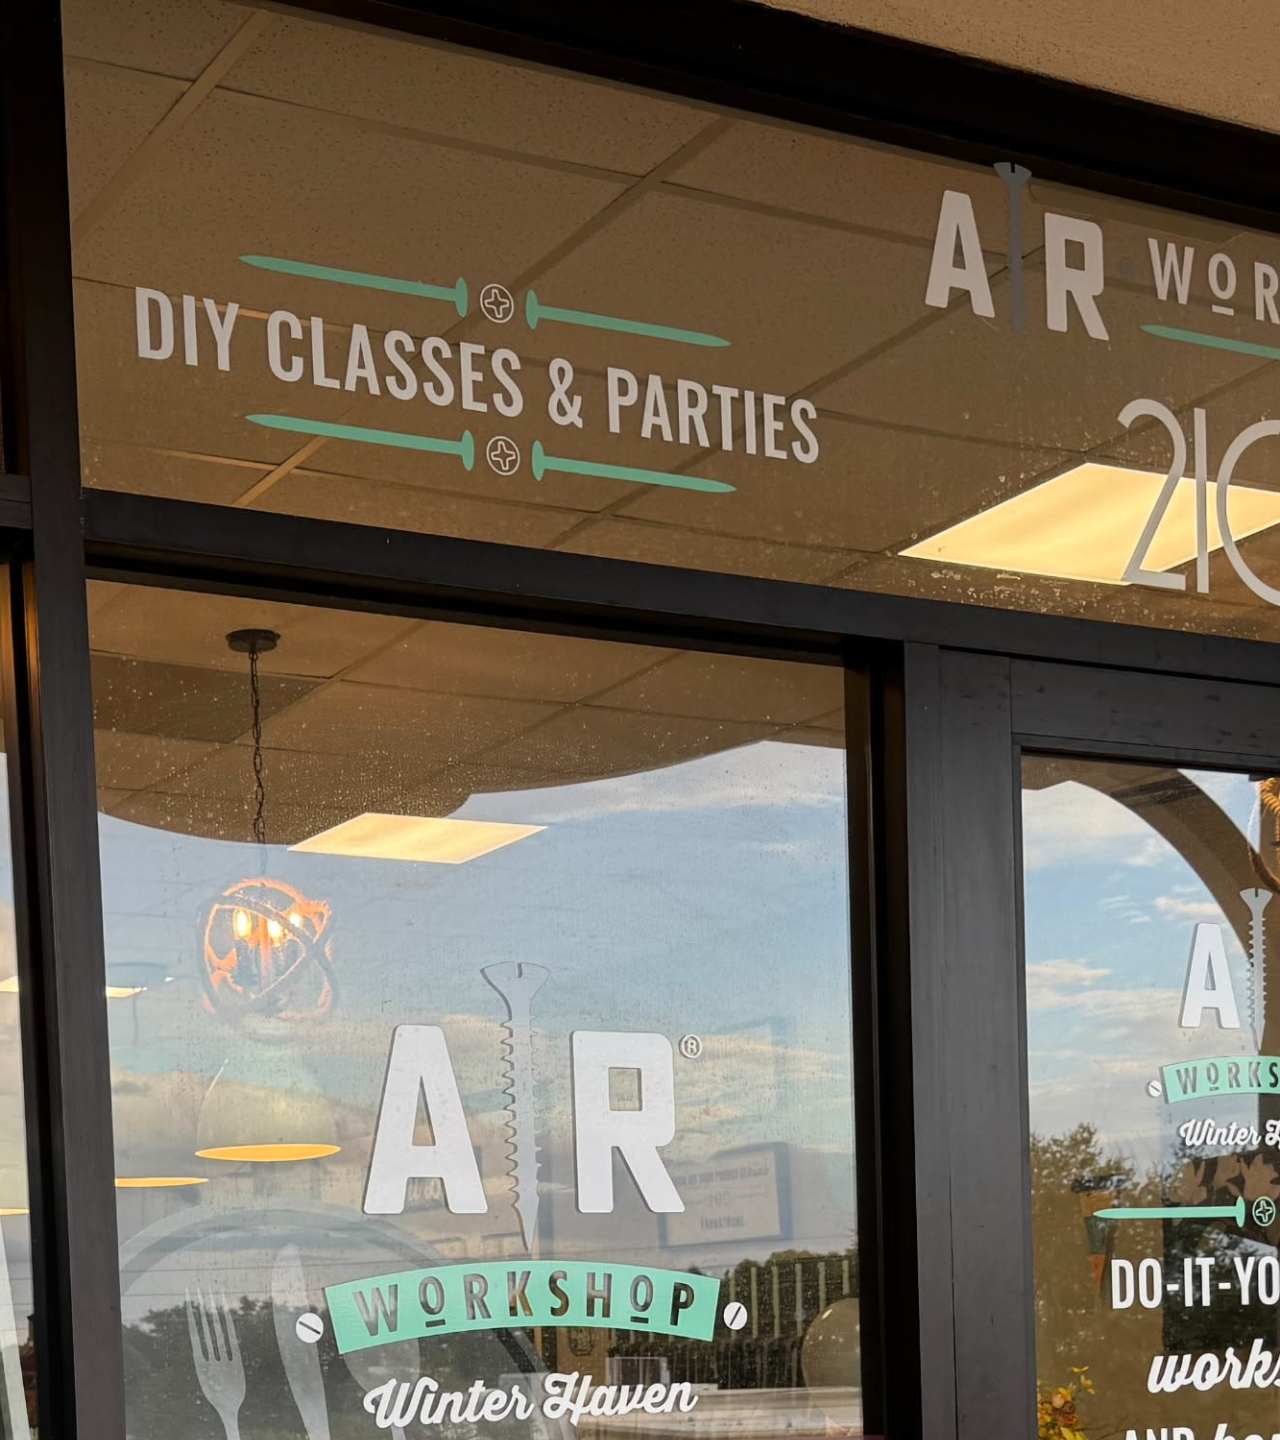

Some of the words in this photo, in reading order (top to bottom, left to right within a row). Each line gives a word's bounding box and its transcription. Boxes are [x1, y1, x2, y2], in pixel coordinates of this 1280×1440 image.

[135, 286, 240, 372] DIY
[268, 310, 524, 418] CLASSES
[548, 357, 584, 429] &
[607, 367, 821, 464] PARTIES
[1178, 1119, 1261, 1148] Winter
[351, 1269, 696, 1338] WORKSHOP
[363, 1376, 534, 1430] Winter
[543, 1371, 699, 1427] Haven
